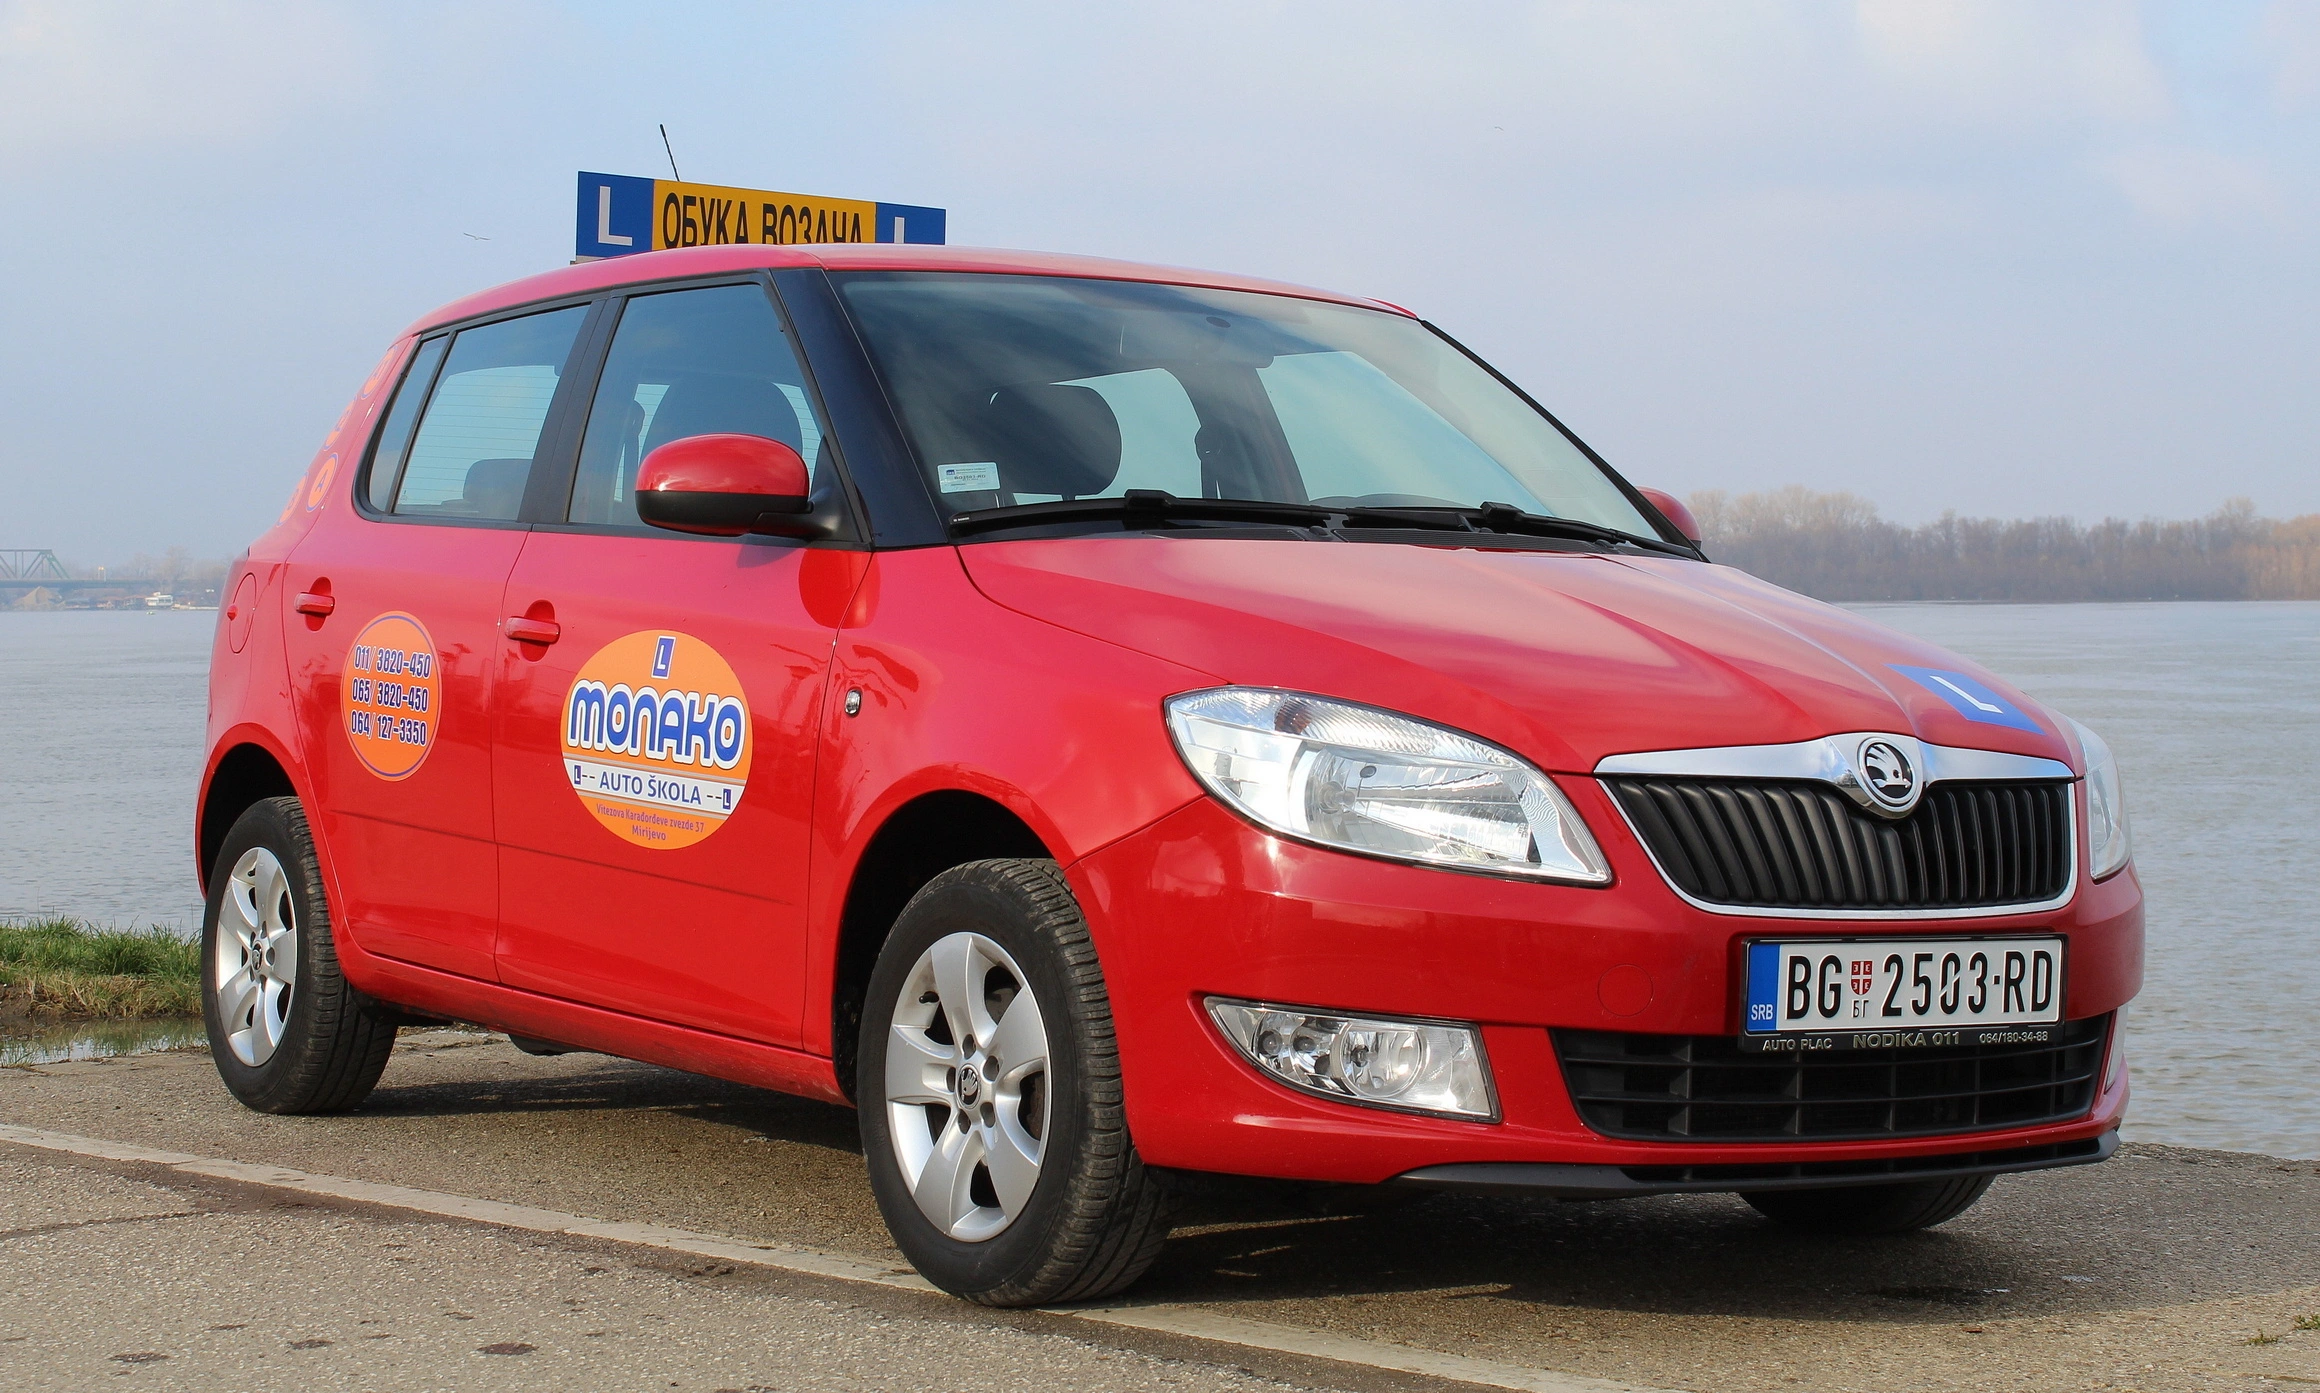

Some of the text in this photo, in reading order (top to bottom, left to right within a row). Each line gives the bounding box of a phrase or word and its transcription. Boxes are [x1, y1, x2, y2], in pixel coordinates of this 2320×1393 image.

[598, 186, 633, 246] L
[662, 192, 750, 248] ОБУКА
[377, 648, 432, 678] 3820-450
[377, 682, 429, 712] 3820-450
[377, 715, 427, 746] 127-3350
[568, 680, 745, 769] MONAKO
[599, 771, 643, 795] AUTO
[647, 775, 702, 805] ŠKOLA
[596, 803, 625, 819] Vitezova
[669, 818, 694, 831] zvezde
[695, 821, 705, 833] 37
[631, 824, 667, 841] Mirijevo
[1785, 953, 1843, 1021] BG
[1750, 1003, 1774, 1021] SRB
[1763, 1039, 1796, 1051] AUTO
[1800, 1038, 1832, 1050] PLAC
[1853, 1032, 1927, 1049] NODIKA
[1932, 1031, 1960, 1046] 011
